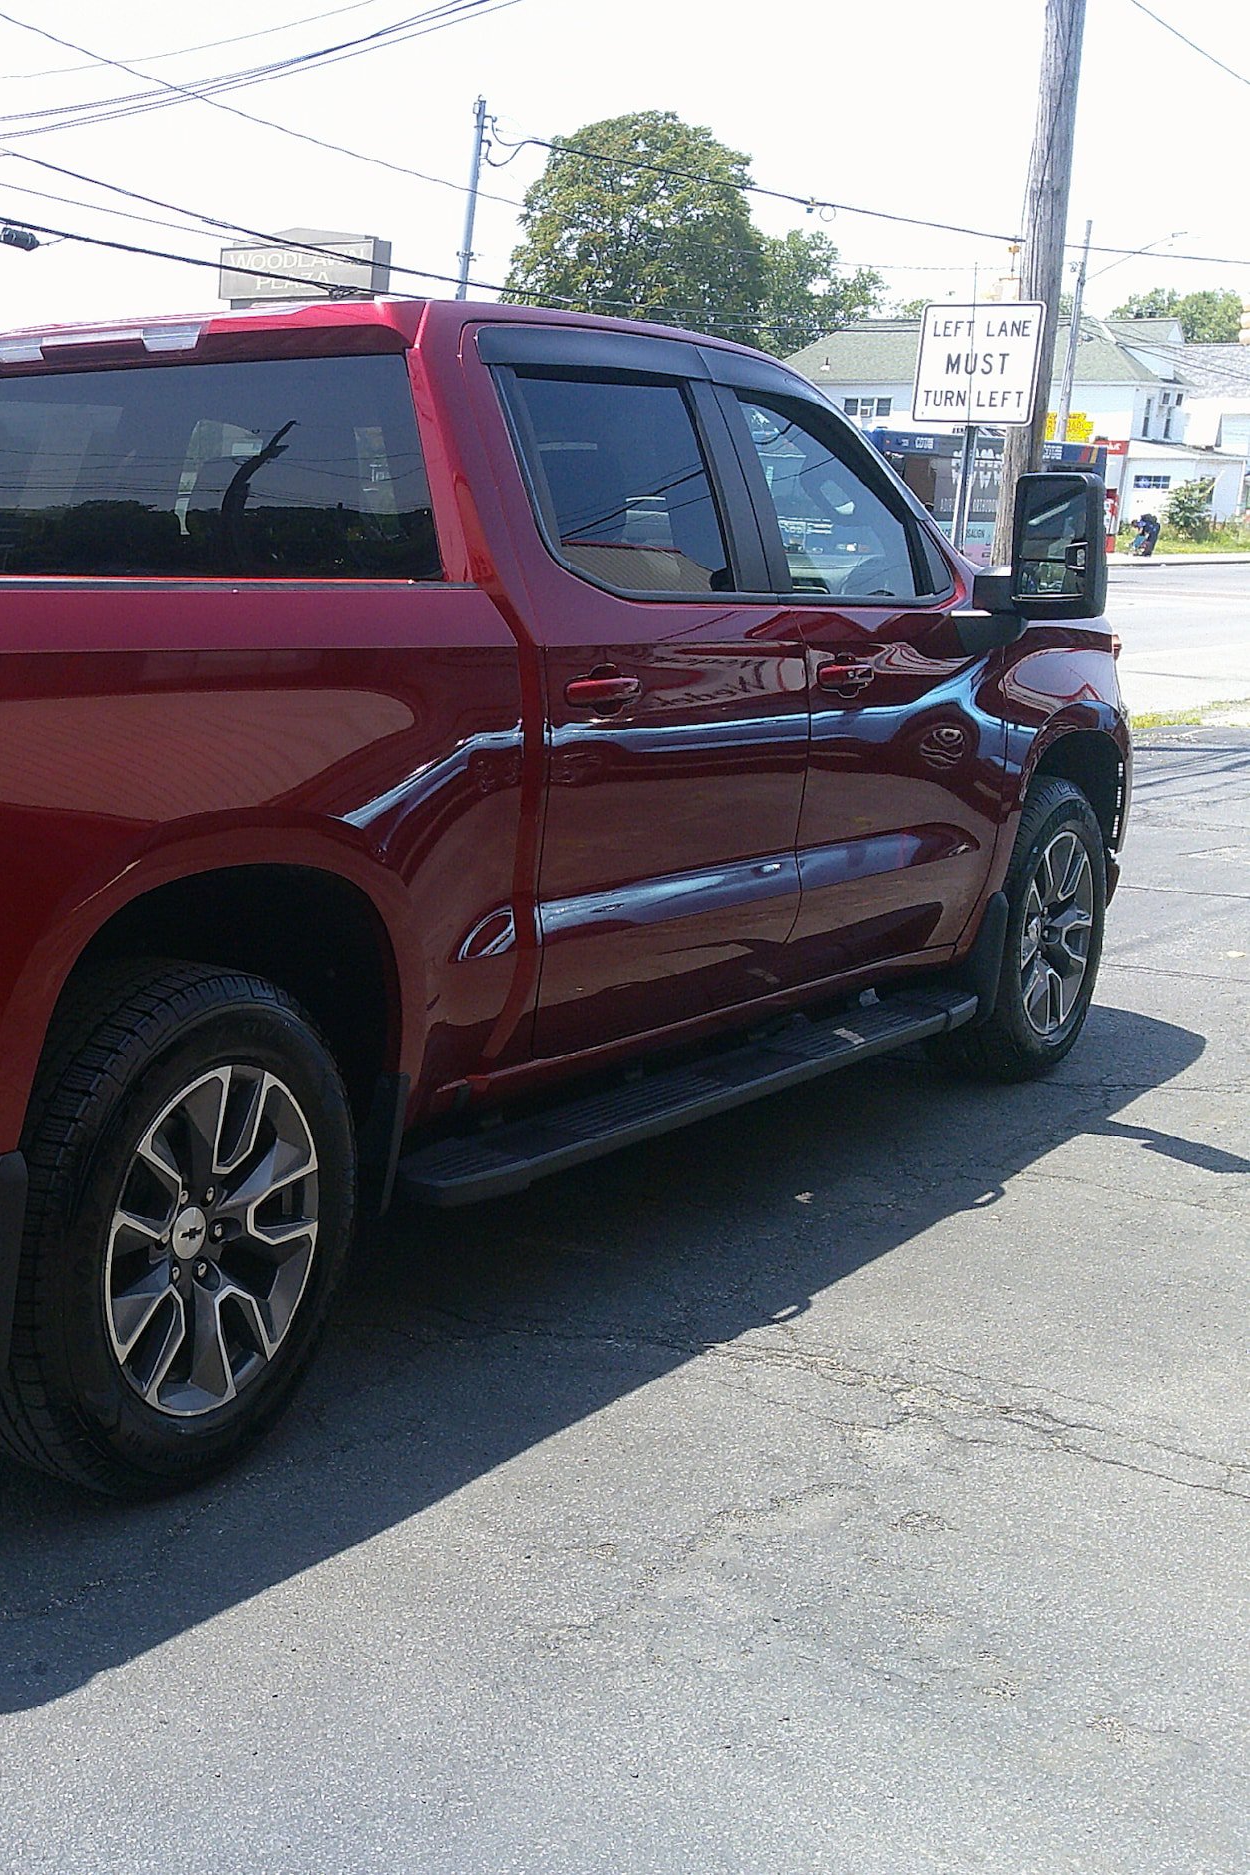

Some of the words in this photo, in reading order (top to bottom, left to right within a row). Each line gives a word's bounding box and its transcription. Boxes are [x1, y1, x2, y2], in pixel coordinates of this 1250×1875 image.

[933, 320, 975, 337] LEFT
[986, 320, 1032, 337] LANE
[945, 353, 1010, 375] MUST
[924, 390, 967, 407] TURN
[976, 390, 1024, 408] LEFT
